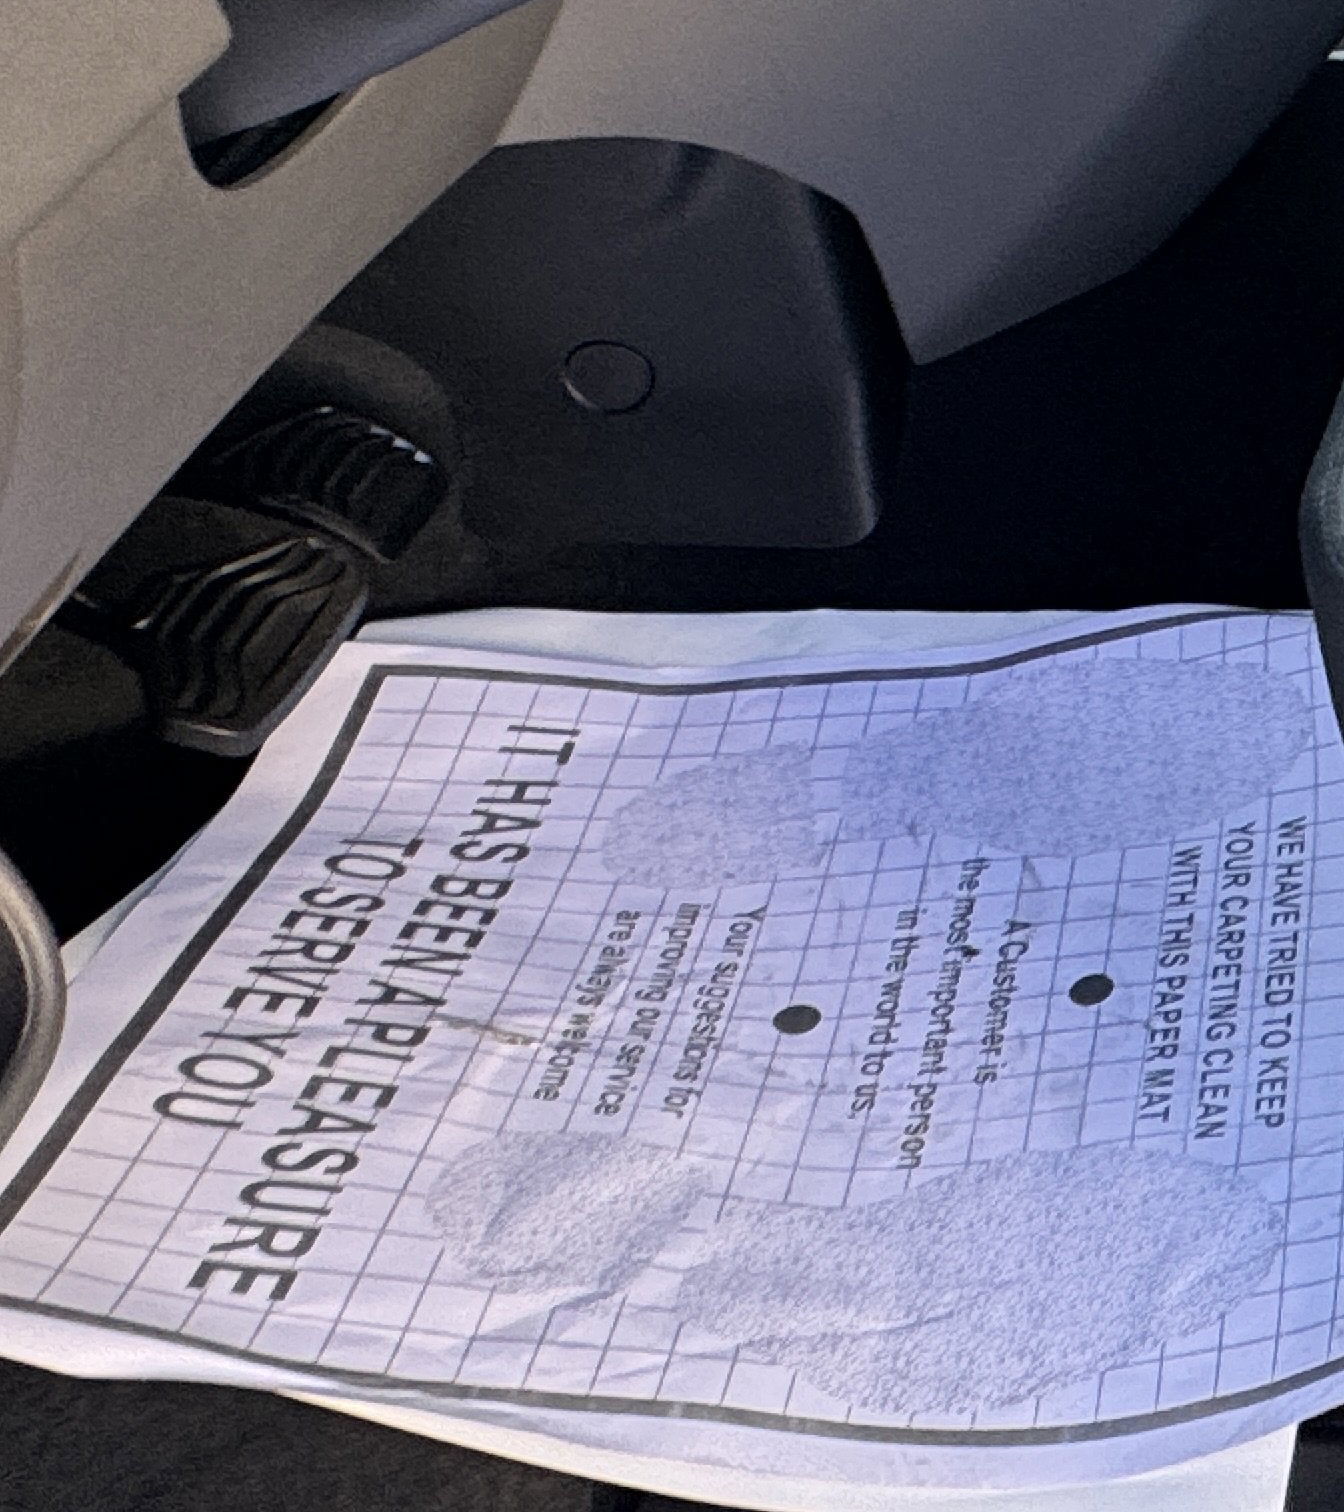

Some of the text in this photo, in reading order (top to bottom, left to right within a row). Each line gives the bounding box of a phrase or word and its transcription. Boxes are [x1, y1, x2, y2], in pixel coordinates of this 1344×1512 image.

[151, 837, 424, 1131] TO SERVE YOU
[185, 723, 581, 1303] IT HAS BEEN A PLEASURE
[532, 909, 642, 1102] are always welcome
[593, 902, 713, 1117] improving our service
[660, 904, 769, 1120] Your suggestions for
[868, 979, 903, 1046] world
[885, 935, 920, 973] the
[894, 906, 928, 931] in
[896, 856, 991, 1170] the most important person
[974, 918, 1032, 1085] A Customer is
[1139, 845, 1202, 1124] WITH THIS PAPER MAT
[1194, 820, 1256, 1139] YOUR CARPETING CLEAN
[1254, 816, 1307, 1129] WE HAVE TRIED TO KEEP
[861, 1050, 893, 1076] to
